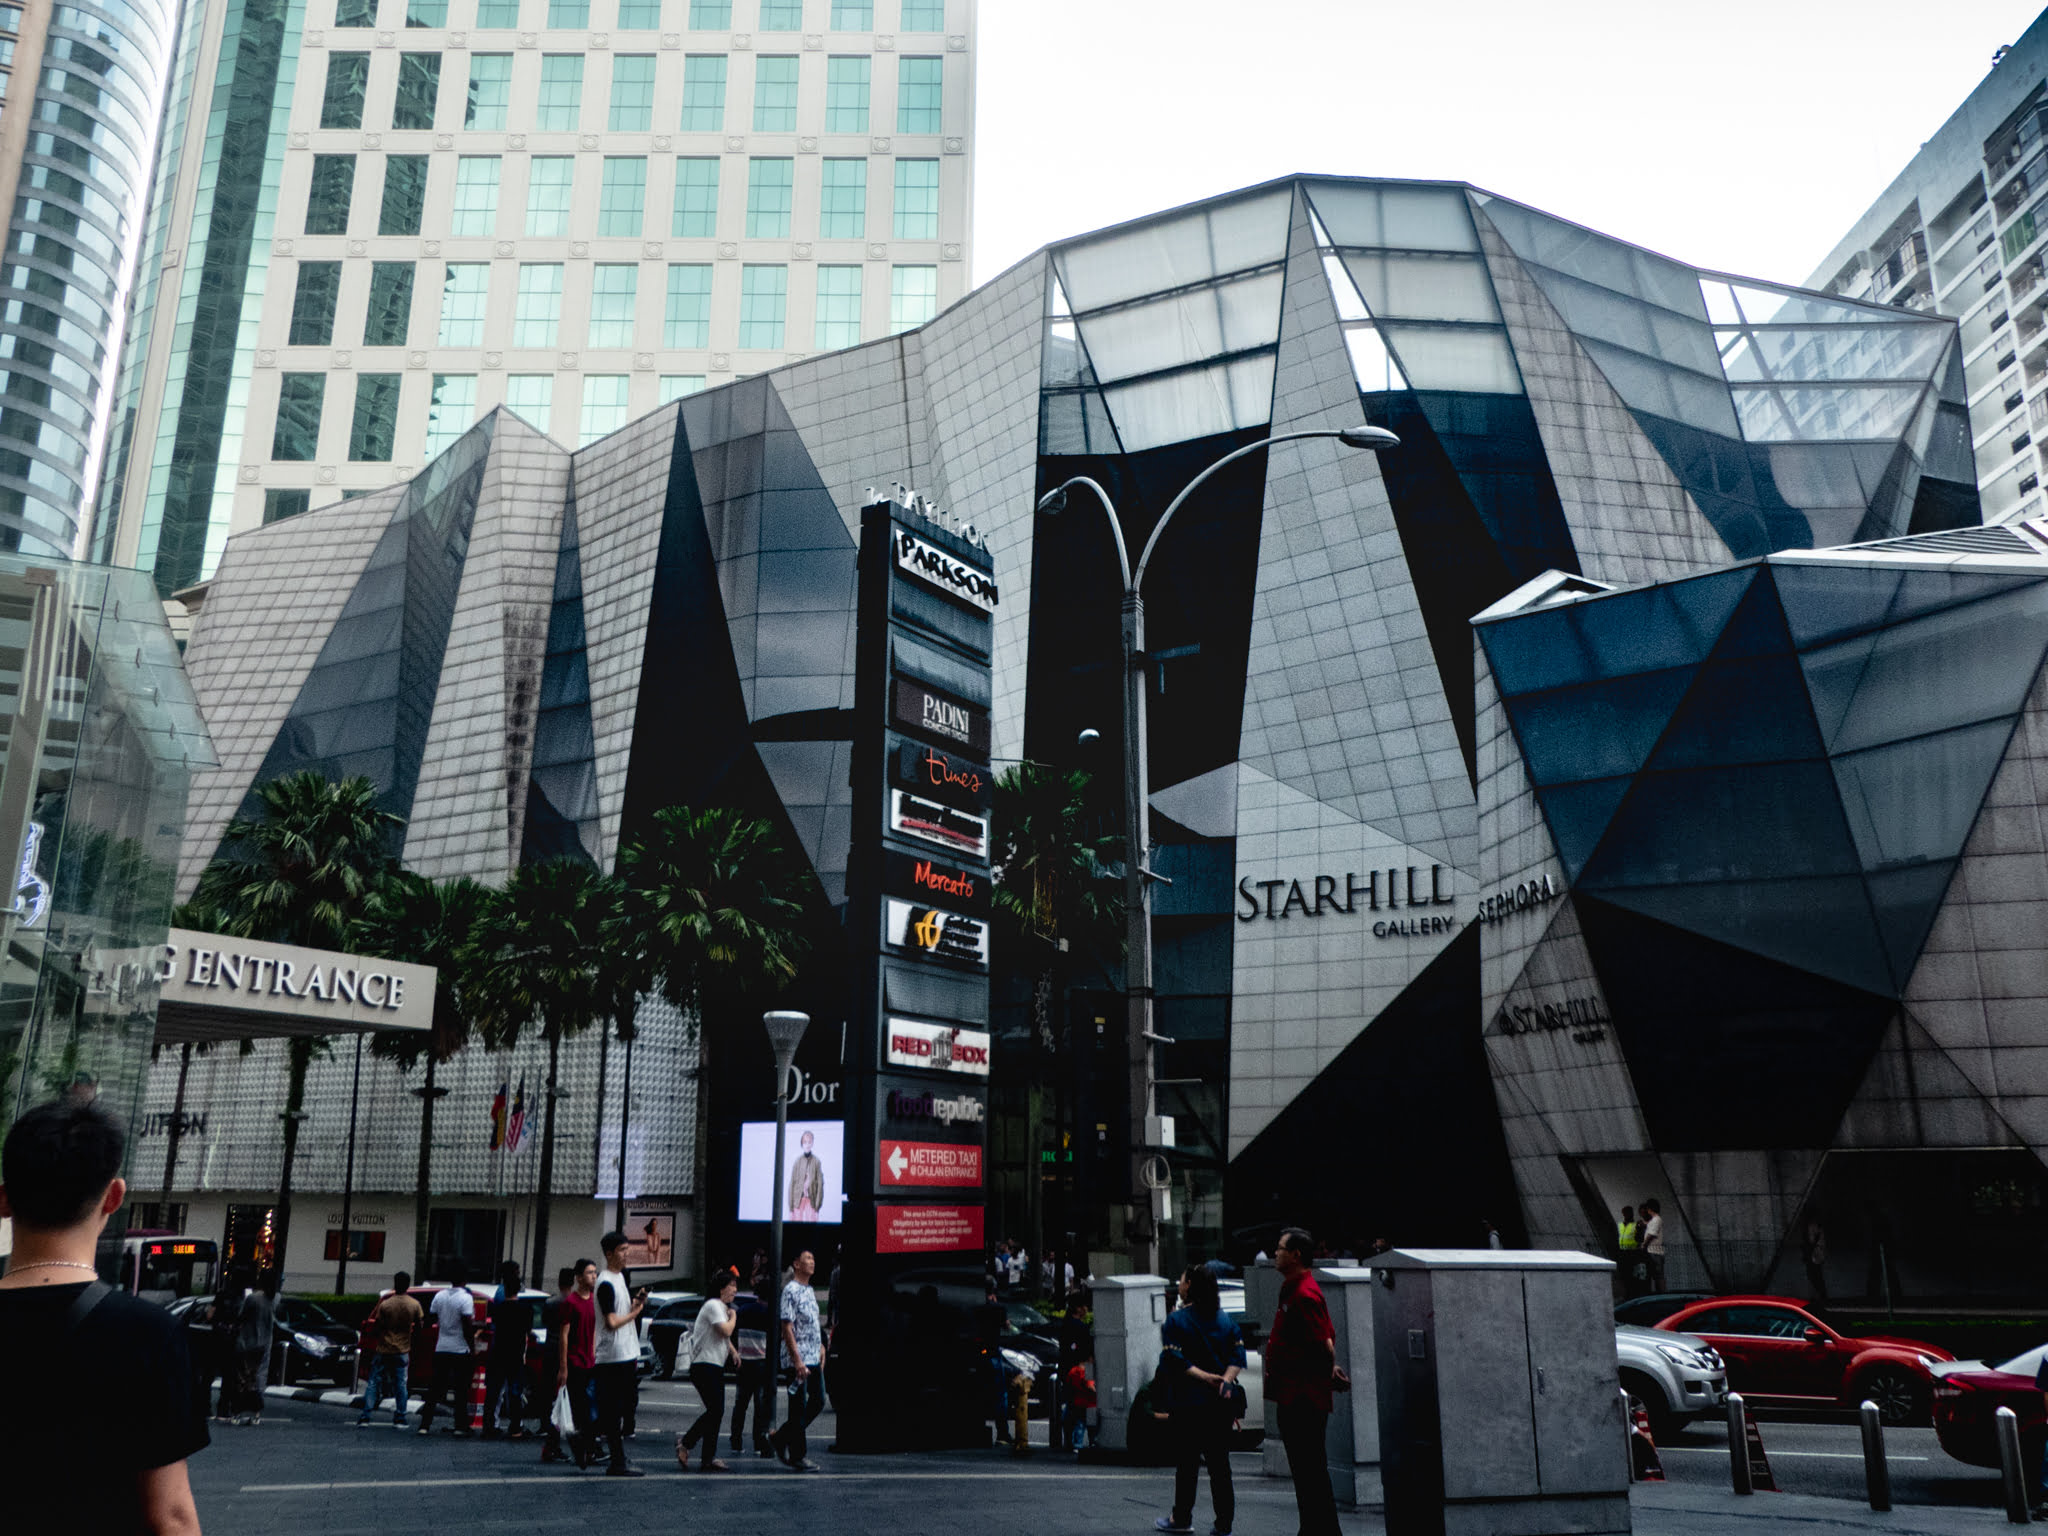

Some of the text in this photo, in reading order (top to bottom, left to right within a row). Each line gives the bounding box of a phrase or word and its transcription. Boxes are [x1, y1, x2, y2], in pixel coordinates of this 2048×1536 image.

[900, 534, 999, 606] PARKSON
[923, 693, 969, 734] PADINI
[926, 748, 983, 795] times
[914, 861, 974, 898] Mercato
[1237, 863, 1453, 923] STARHILL
[1478, 874, 1553, 924] SEPHORA
[1372, 915, 1454, 939] GALLERY
[187, 949, 405, 1009] ENTRANCE
[892, 1035, 931, 1057] RED
[951, 1043, 988, 1066] BOX
[772, 1065, 840, 1105] Dior
[910, 1148, 977, 1166] METERED TAXI
[944, 1166, 977, 1178] ENTRANCE
[352, 1214, 385, 1225] VUITTON
